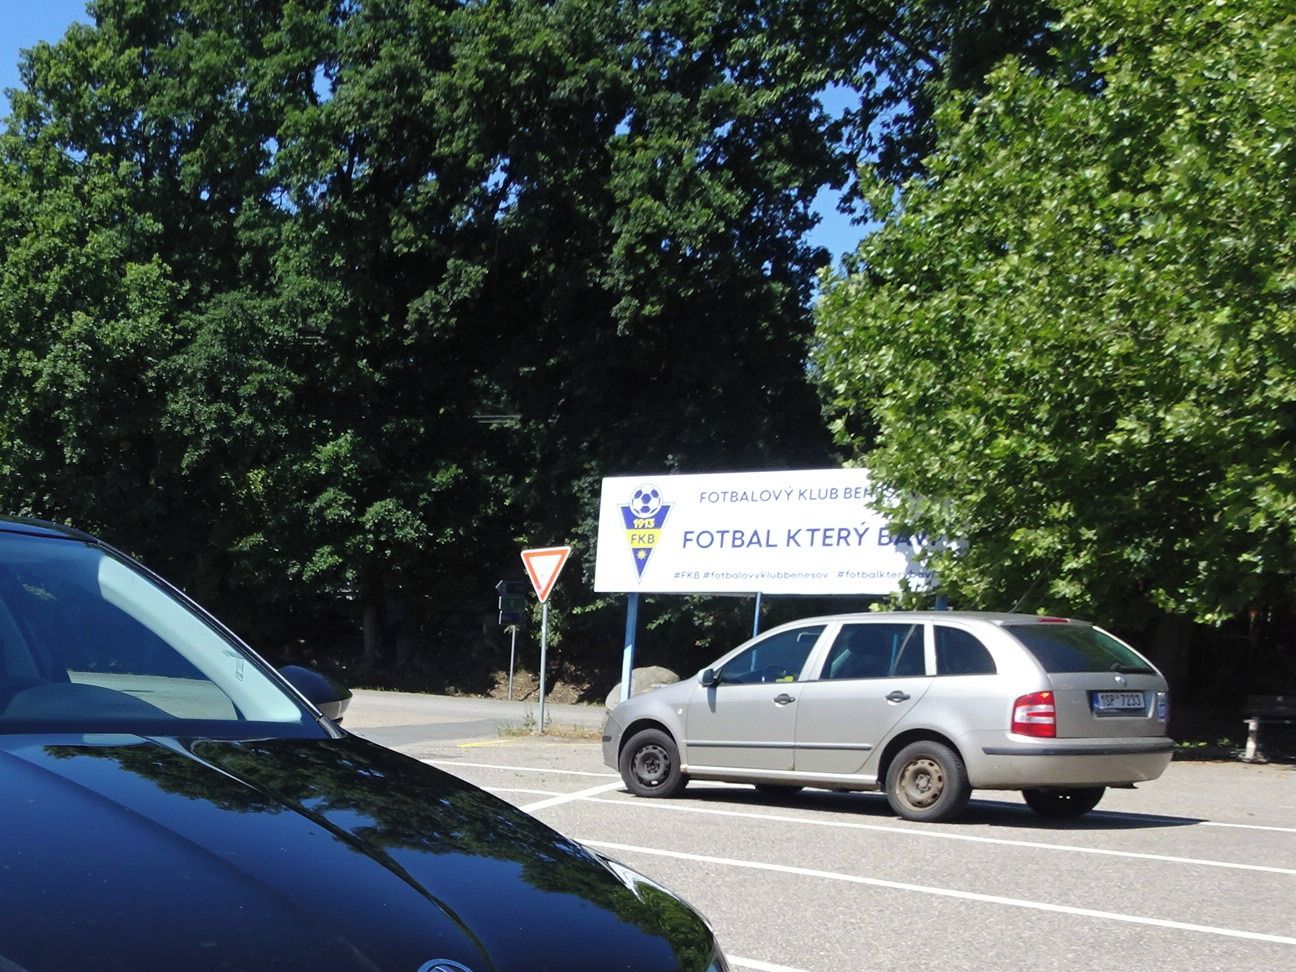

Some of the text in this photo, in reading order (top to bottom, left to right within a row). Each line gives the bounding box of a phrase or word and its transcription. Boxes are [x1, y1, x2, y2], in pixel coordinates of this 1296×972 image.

[699, 485, 794, 504] FOTBALOVÝ
[798, 487, 839, 501] KLUB
[631, 533, 655, 545] FKB
[683, 529, 778, 549] FOTBAL
[786, 521, 870, 548] KTERÝ
[673, 571, 701, 580] #FKB
